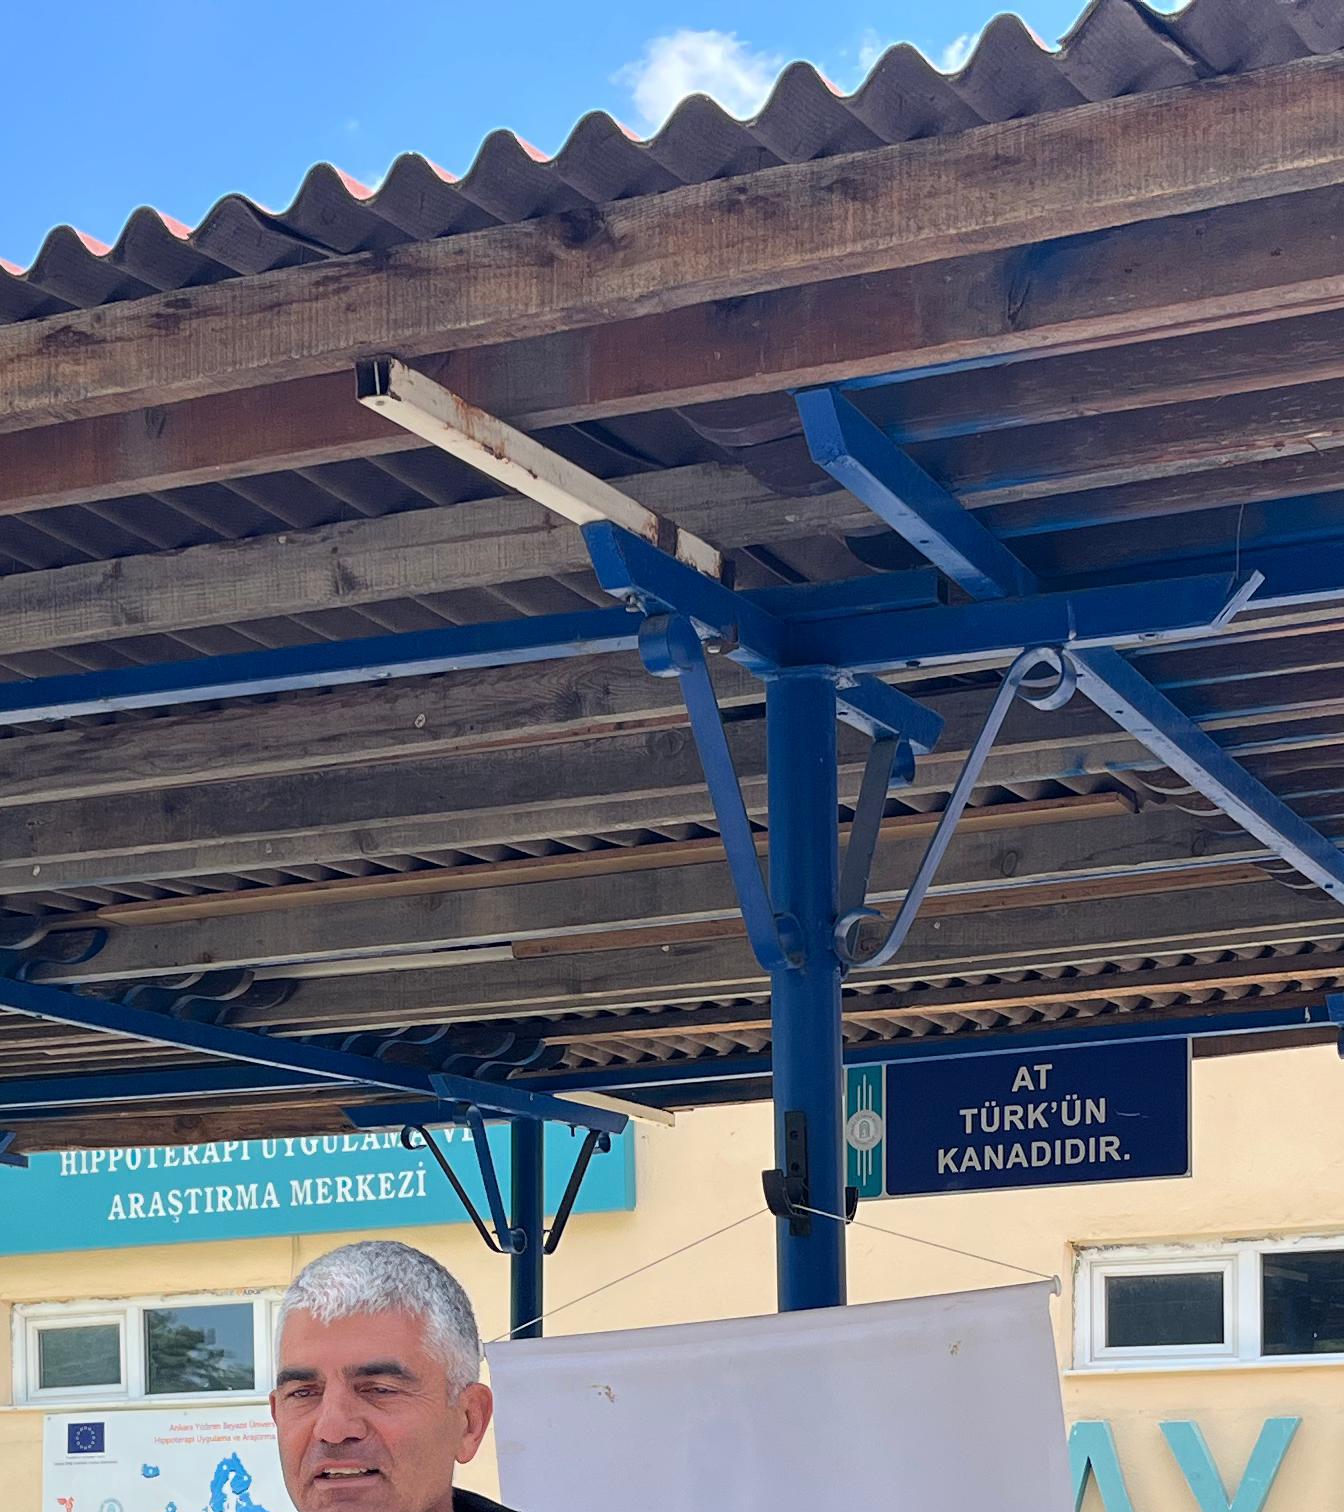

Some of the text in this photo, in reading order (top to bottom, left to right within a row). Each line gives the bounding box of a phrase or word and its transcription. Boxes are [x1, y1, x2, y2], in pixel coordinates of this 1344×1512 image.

[1012, 1064, 1053, 1092] AT
[959, 1094, 1106, 1134] TÜRK'ÜN
[937, 1135, 1131, 1174] KANADIDIR.
[108, 1161, 427, 1224] ARAŞTIRMA MERKEZİ
